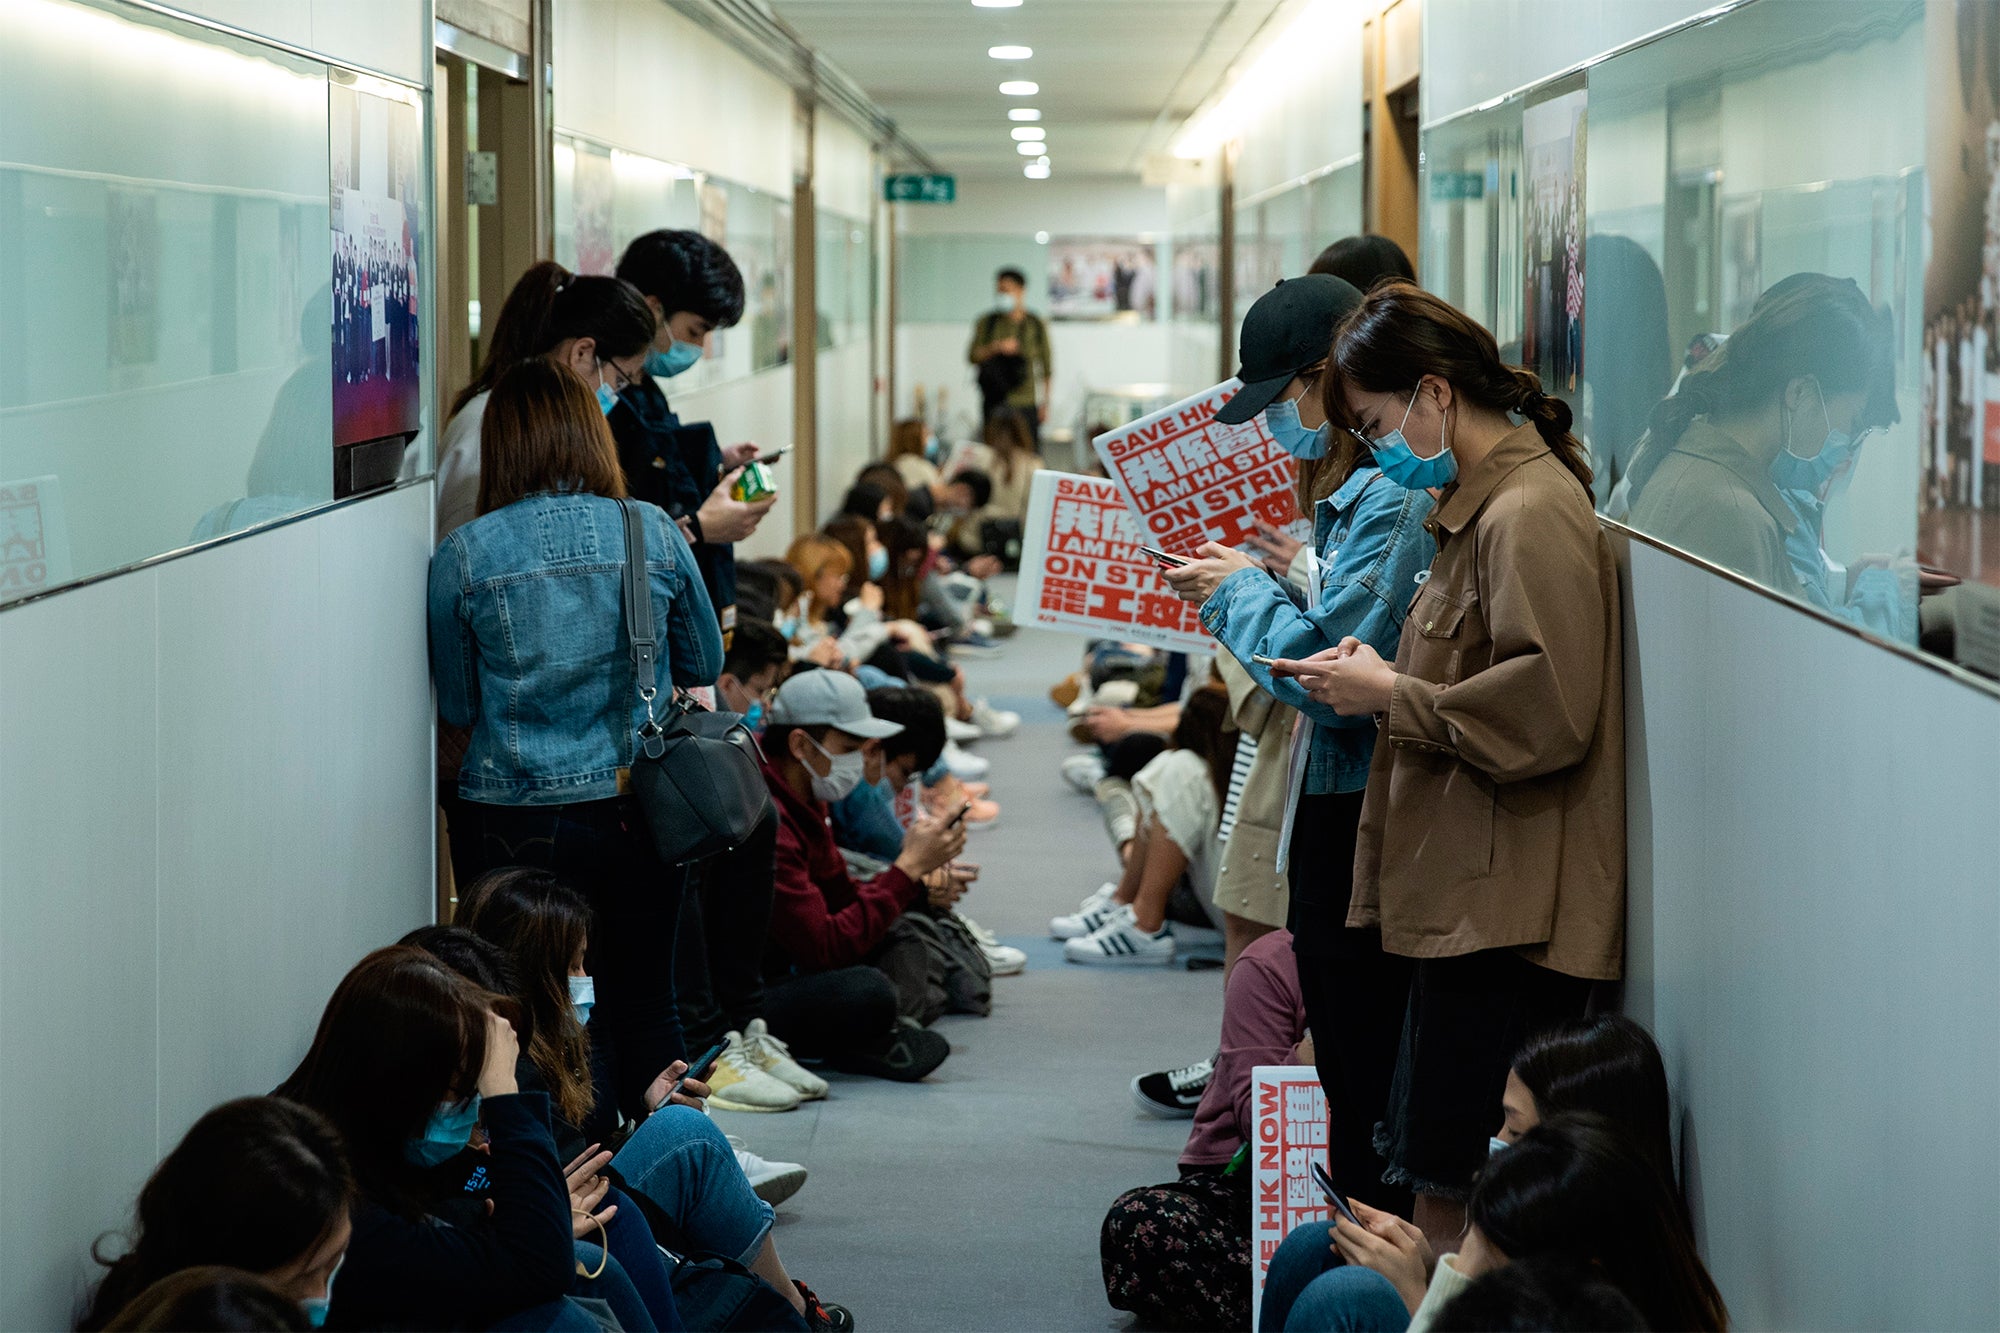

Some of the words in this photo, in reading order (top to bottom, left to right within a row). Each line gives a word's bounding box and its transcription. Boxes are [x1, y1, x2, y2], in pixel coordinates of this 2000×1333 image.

[1107, 416, 1179, 457] SAVE
[1179, 398, 1218, 428] HK
[1119, 412, 1273, 495] 我係醫
[1137, 494, 1150, 514] I
[1153, 478, 1194, 506] AM
[1194, 463, 1233, 490] HA
[1232, 440, 1287, 472] STA
[1147, 501, 1203, 533] ON
[1203, 457, 1297, 511] STRI
[1051, 533, 1061, 550] I
[1063, 536, 1105, 559] AM
[1156, 488, 1303, 559] 罷工救
[1045, 555, 1096, 580] ON
[1260, 1082, 1279, 1170] NOW
[464, 1166, 486, 1192] 15:16
[1260, 1178, 1279, 1230] HK
